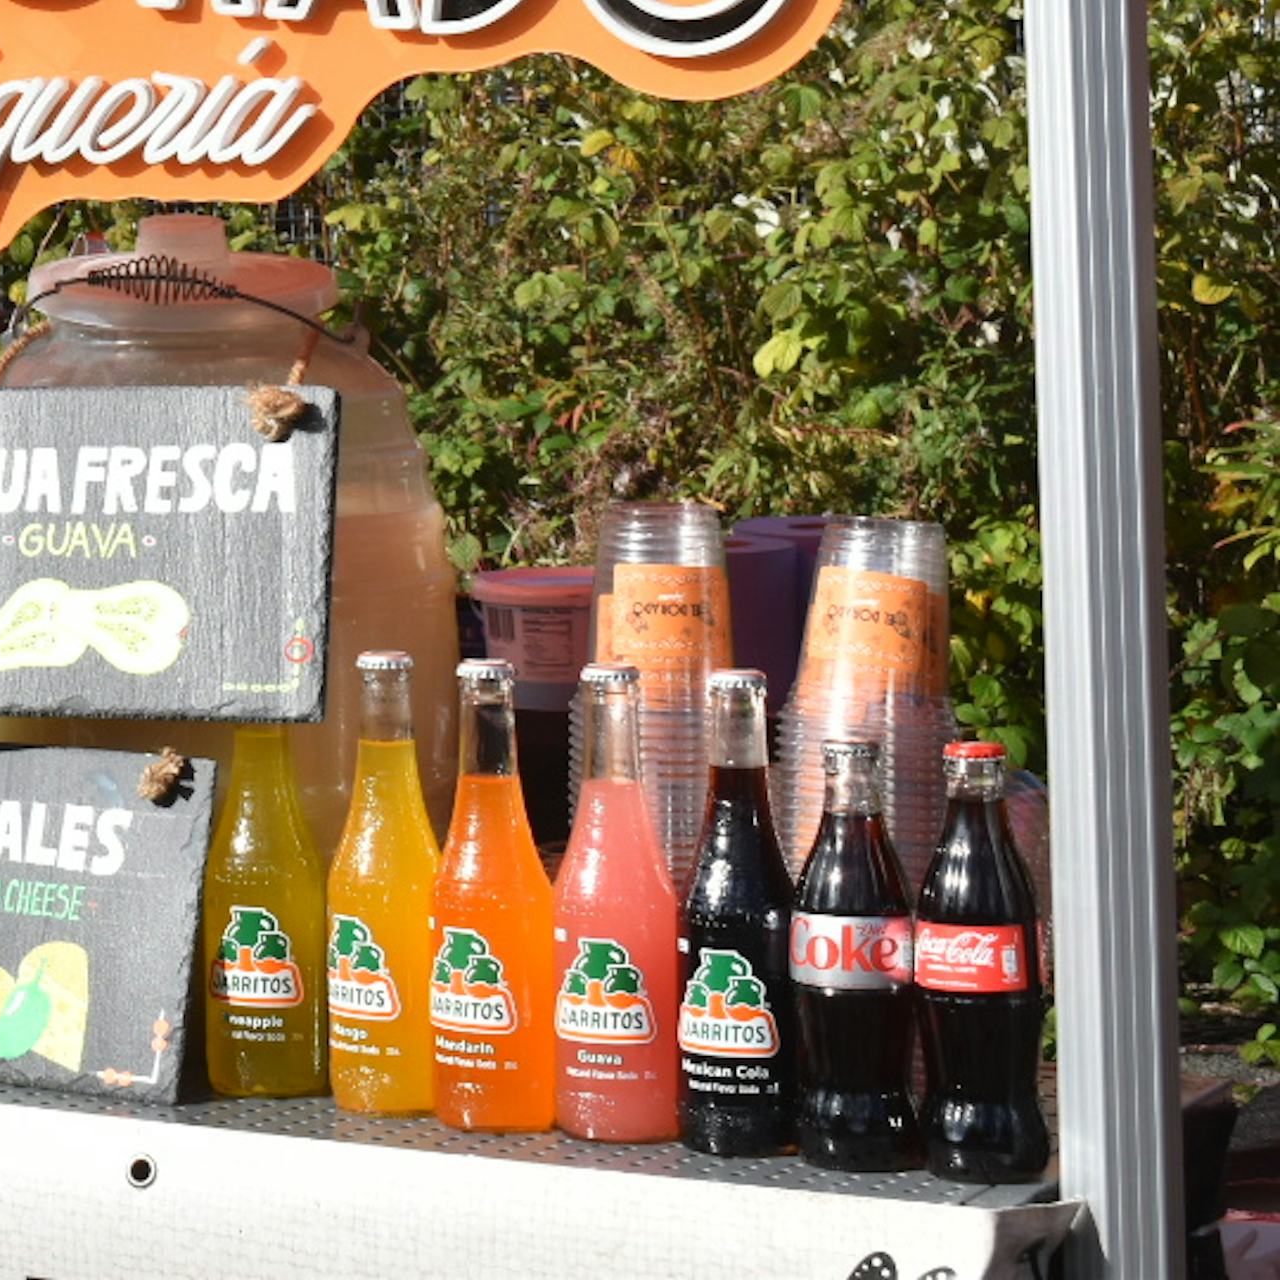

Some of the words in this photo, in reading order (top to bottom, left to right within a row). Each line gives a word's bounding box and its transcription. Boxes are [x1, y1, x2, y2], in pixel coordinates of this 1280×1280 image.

[70, 442, 296, 516] FRESCA
[17, 521, 137, 559] GUAVA
[4, 879, 87, 921] CHEESE
[790, 917, 899, 972] Coke
[560, 1007, 643, 1030] JARRITOS
[684, 1021, 766, 1044] JARRITOS
[435, 1034, 495, 1055] Mandarin
[577, 1049, 623, 1066] Guava
[681, 1057, 732, 1078] Mexican
[736, 1064, 770, 1080] Cola
